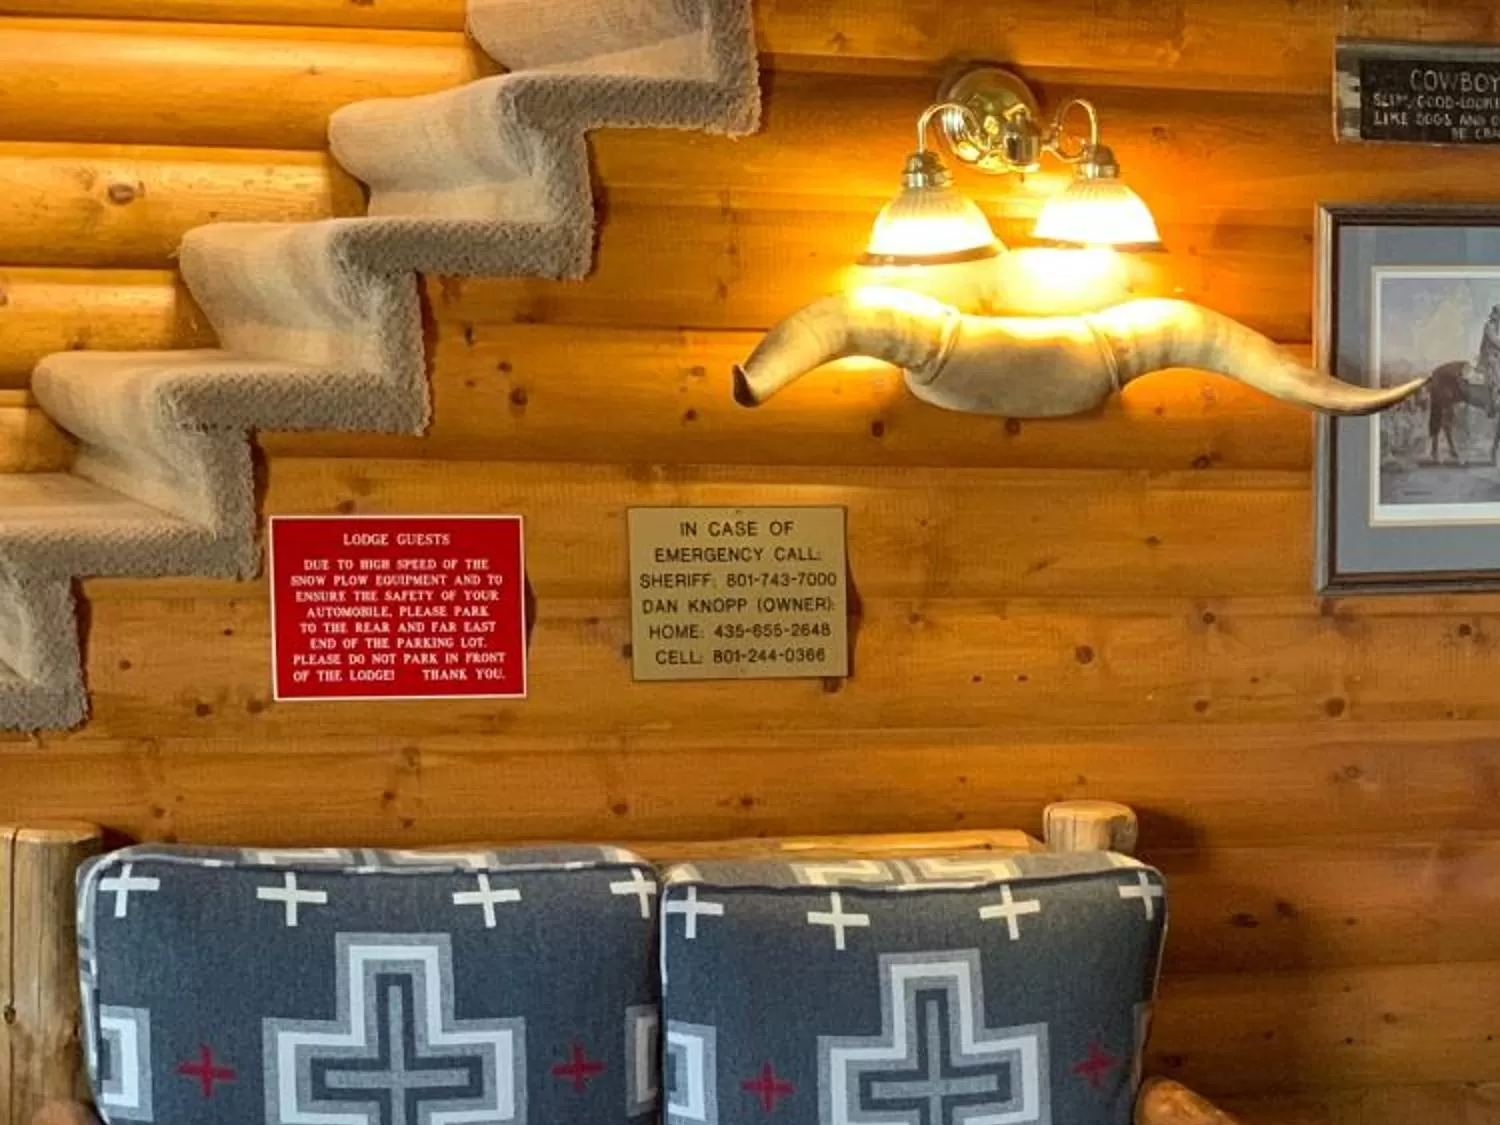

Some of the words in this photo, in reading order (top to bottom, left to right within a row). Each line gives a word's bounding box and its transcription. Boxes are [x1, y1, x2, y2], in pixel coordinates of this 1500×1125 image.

[680, 521, 697, 537] IN
[708, 521, 758, 537] CASE
[769, 520, 795, 536] OF
[343, 533, 389, 546] LODGE
[397, 533, 450, 546] GUESTS
[654, 547, 764, 563] EMERGENCY
[303, 558, 330, 571] DUE
[337, 558, 354, 570] TO
[360, 558, 390, 570] HIGH
[397, 558, 437, 570] SPEED
[442, 558, 458, 570] OF
[464, 558, 490, 570] THE
[290, 575, 327, 587] SNOW
[333, 575, 368, 587] PLOW
[375, 574, 447, 586] EQUIPMENT
[454, 574, 481, 586] AND
[487, 574, 503, 586] TO
[726, 571, 837, 588] 801-743-7000
[295, 590, 347, 603] ENSURE
[353, 590, 379, 602] THE
[384, 590, 434, 602] SAFETY
[441, 589, 457, 601] OF
[464, 589, 500, 602] YOUR
[399, 605, 448, 617] PLEASE
[453, 605, 490, 617] PARK
[642, 599, 678, 615] DAN
[688, 598, 747, 614] KNOPP
[299, 622, 317, 634] TO
[323, 622, 348, 634] THE
[355, 622, 390, 633] REAR
[397, 621, 425, 633] AND
[431, 621, 457, 633] FAR
[463, 621, 497, 633] EAST
[310, 637, 337, 649] END
[342, 637, 359, 649] OF
[364, 637, 391, 649] THE
[397, 637, 454, 649] PARKING
[292, 653, 342, 666] PLEASE
[348, 653, 366, 665] DO
[371, 653, 397, 665] NOT
[403, 652, 439, 665] PARK
[445, 652, 459, 664] IN
[465, 651, 506, 663] FRONT
[292, 669, 311, 682] OF
[315, 669, 343, 682] THE
[421, 669, 468, 681] THANK
